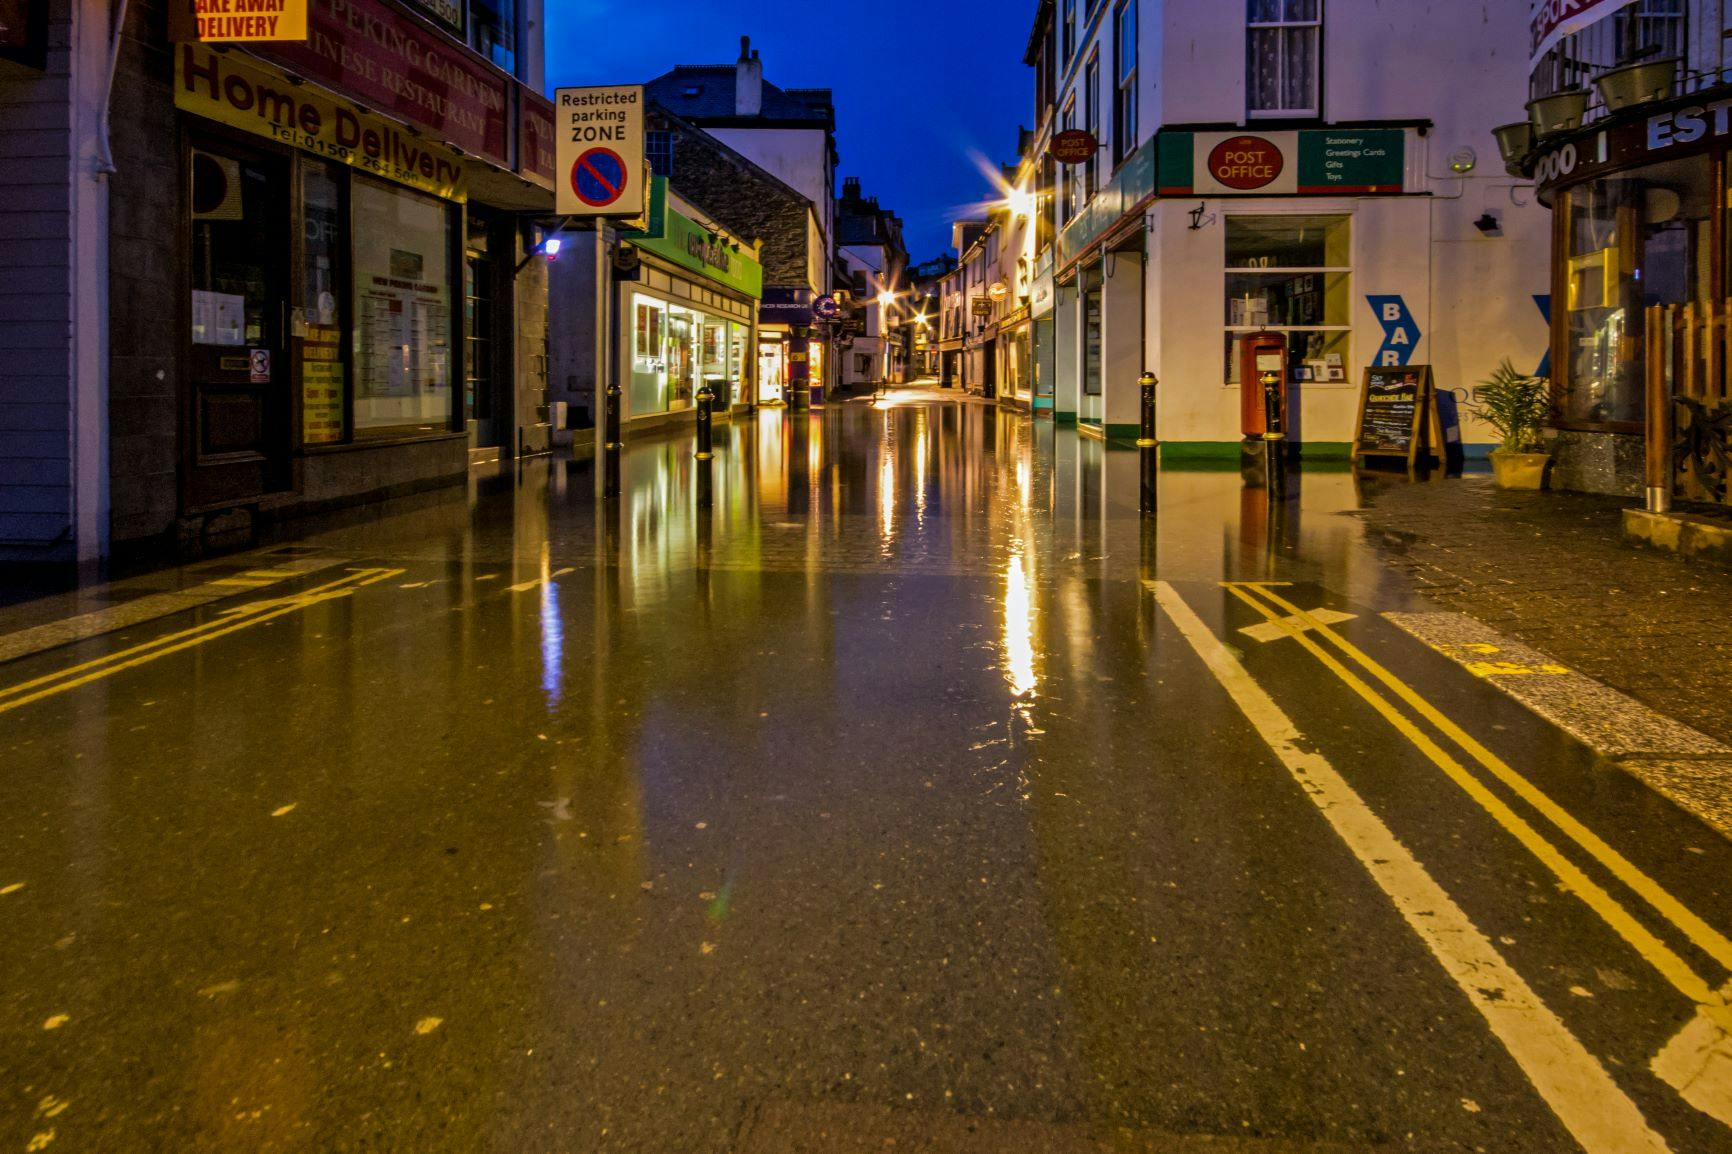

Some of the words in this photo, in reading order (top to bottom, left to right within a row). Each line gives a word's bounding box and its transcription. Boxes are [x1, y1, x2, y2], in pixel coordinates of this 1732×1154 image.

[234, 0, 286, 12] AWAY
[197, 16, 279, 37] DELIVERY
[330, 0, 420, 66] PEKING
[424, 51, 502, 112] GARDEN
[184, 44, 321, 135] Home
[382, 70, 487, 135] RESTAURANT
[562, 92, 637, 106] Restricted
[572, 109, 626, 124] parking
[572, 126, 626, 142] ZONE
[1061, 138, 1086, 147] POST
[1325, 137, 1364, 146] Stationery
[1057, 147, 1090, 157] OFFICE
[1225, 151, 1266, 164] POST
[1325, 148, 1361, 158] Greetings
[1362, 148, 1386, 157] Cards
[1325, 160, 1344, 169] Gifts
[1218, 165, 1273, 178] OFFICE
[1324, 172, 1343, 182] Toys
[1382, 303, 1409, 366] BAR
